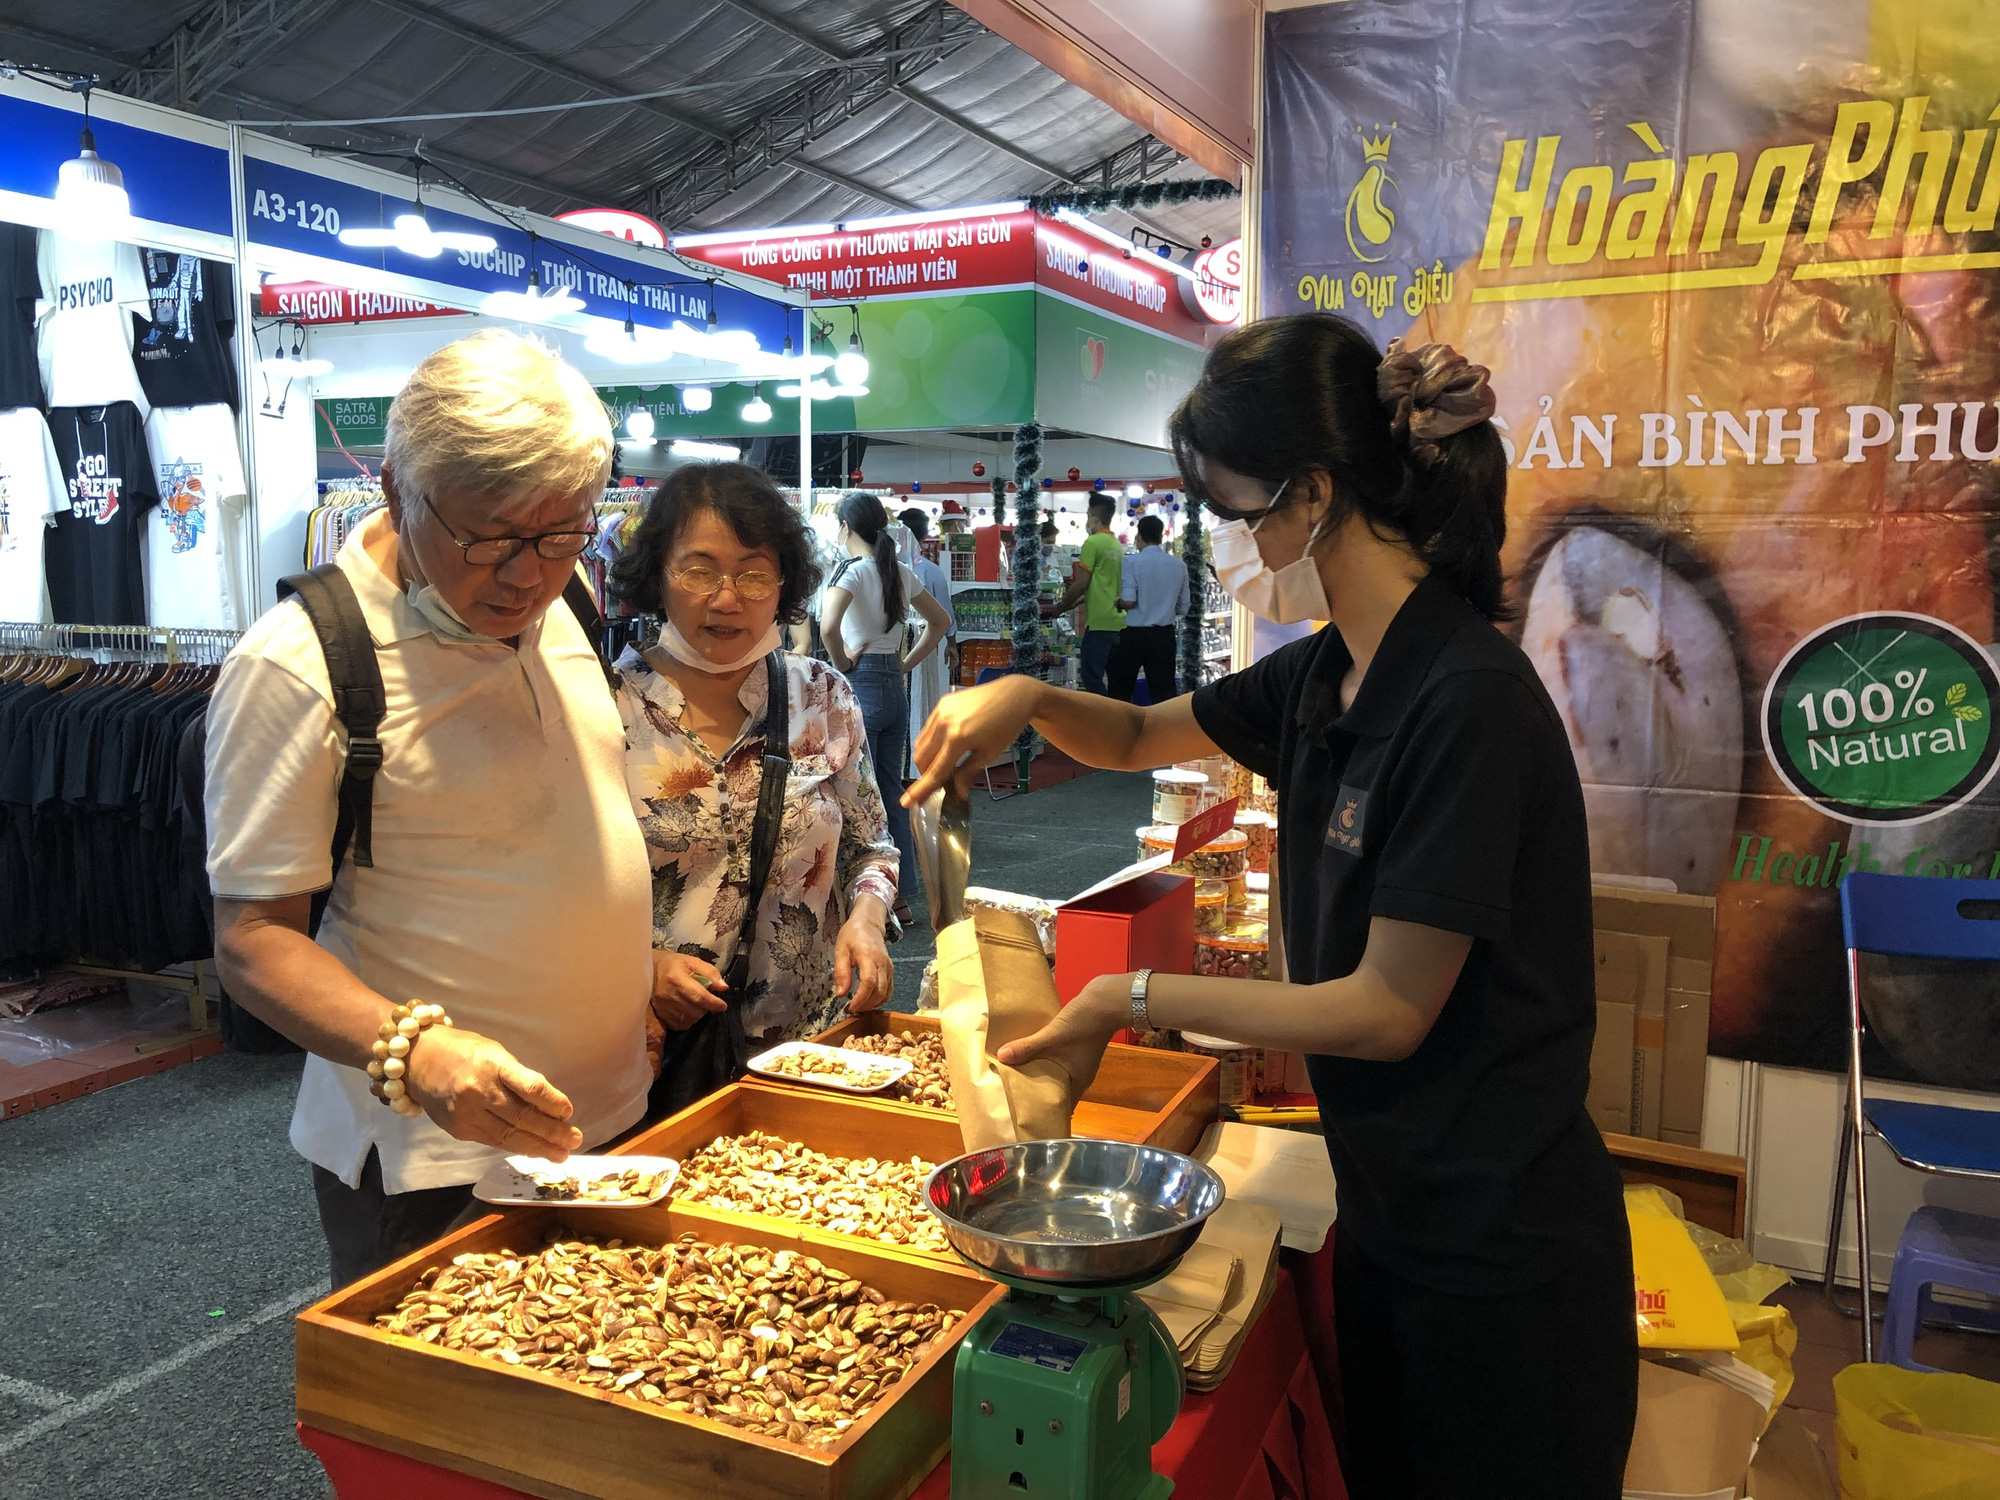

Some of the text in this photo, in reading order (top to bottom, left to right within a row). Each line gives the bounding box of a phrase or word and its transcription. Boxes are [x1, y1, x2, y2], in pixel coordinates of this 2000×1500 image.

[253, 189, 340, 235] A3-120
[782, 238, 822, 263] CÔNG
[827, 238, 844, 259] TY
[914, 228, 942, 254] MẠI
[947, 221, 972, 248] SÀI
[977, 217, 1011, 245] GÒN
[542, 260, 581, 292] THỜI
[586, 271, 638, 305] TRANG
[680, 294, 707, 320] LAN
[787, 256, 957, 294] TNHH MỘT THÀNH VIÊN
[1298, 275, 1344, 311] VUA
[59, 277, 113, 311] PSYCHO
[278, 290, 343, 320] SAIGON
[1135, 280, 1167, 313] GROUP
[335, 402, 376, 414] SATRA
[336, 415, 376, 425] FOODS
[1638, 395, 1820, 467] BÌNH
[86, 454, 106, 476] GO
[1797, 668, 1934, 731] 100%
[1807, 717, 1967, 770] Natural
